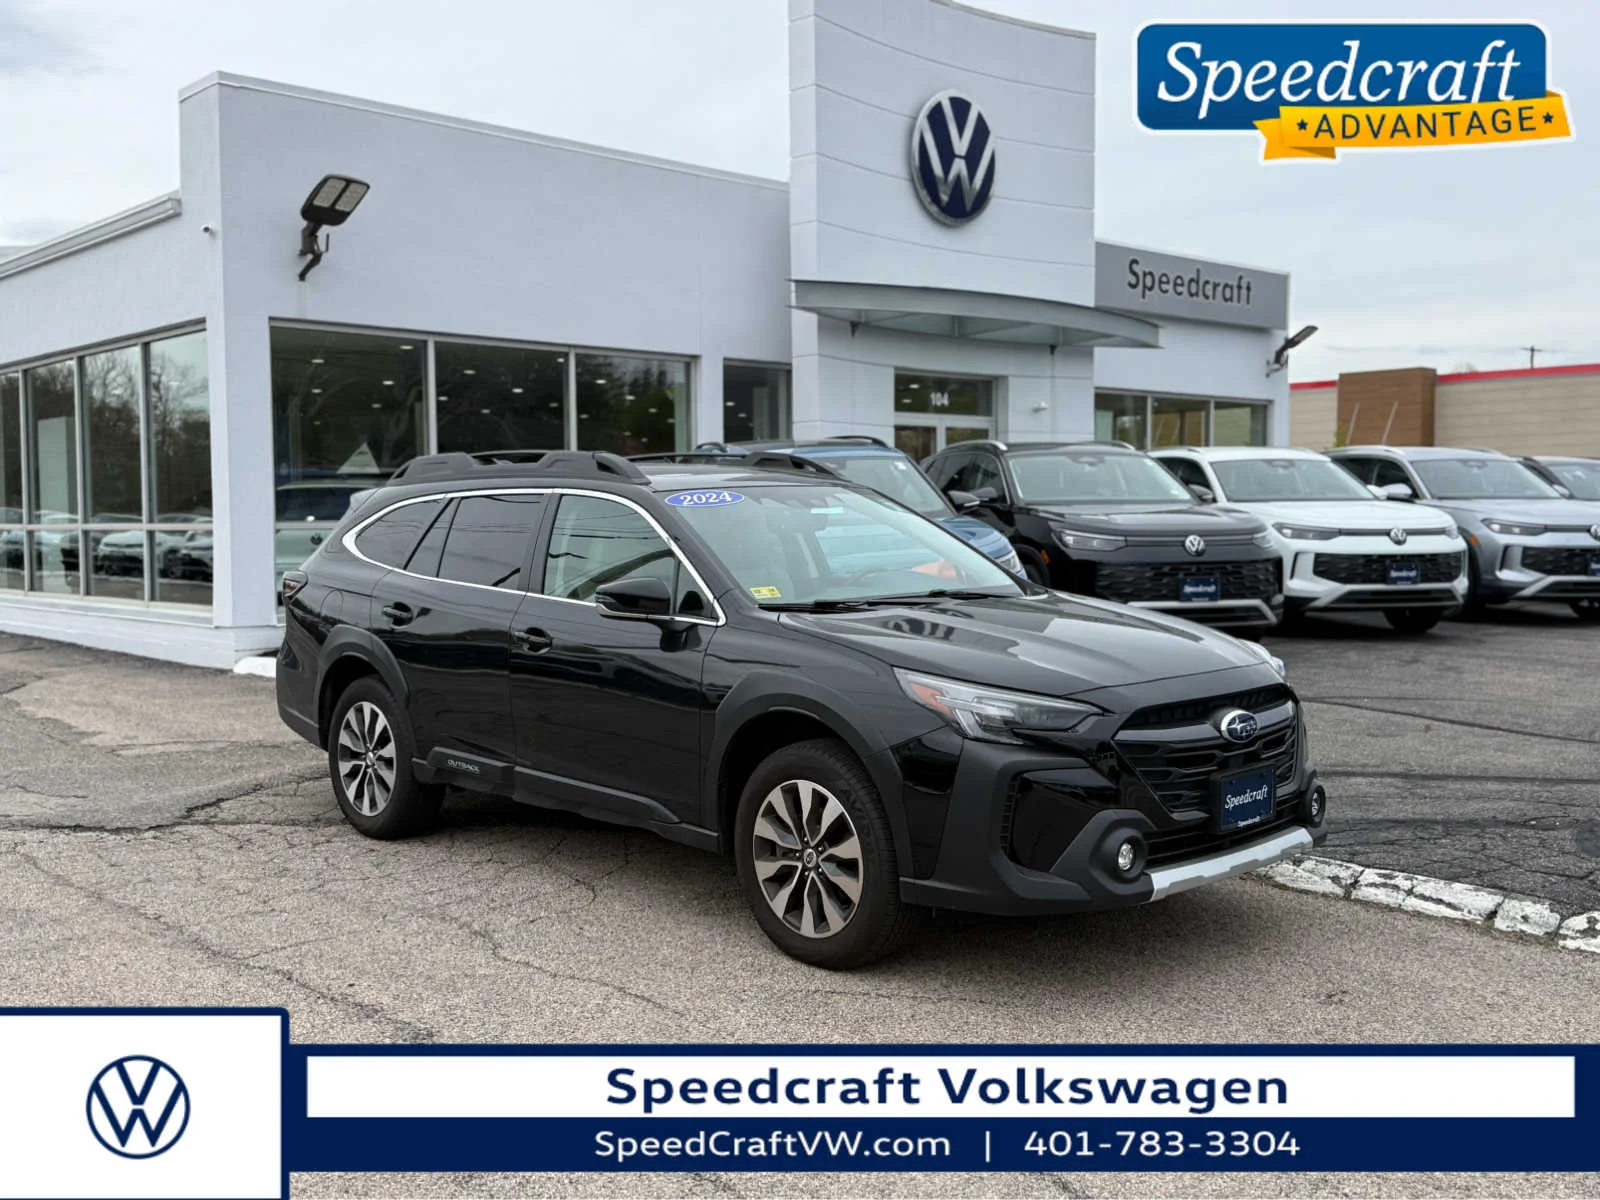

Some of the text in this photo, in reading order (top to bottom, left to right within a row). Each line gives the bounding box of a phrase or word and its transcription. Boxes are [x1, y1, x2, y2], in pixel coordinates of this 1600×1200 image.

[1127, 258, 1252, 305] Speedcraft
[930, 391, 949, 407] 104
[680, 491, 733, 505] 2024
[1224, 784, 1268, 812] Speedcraft
